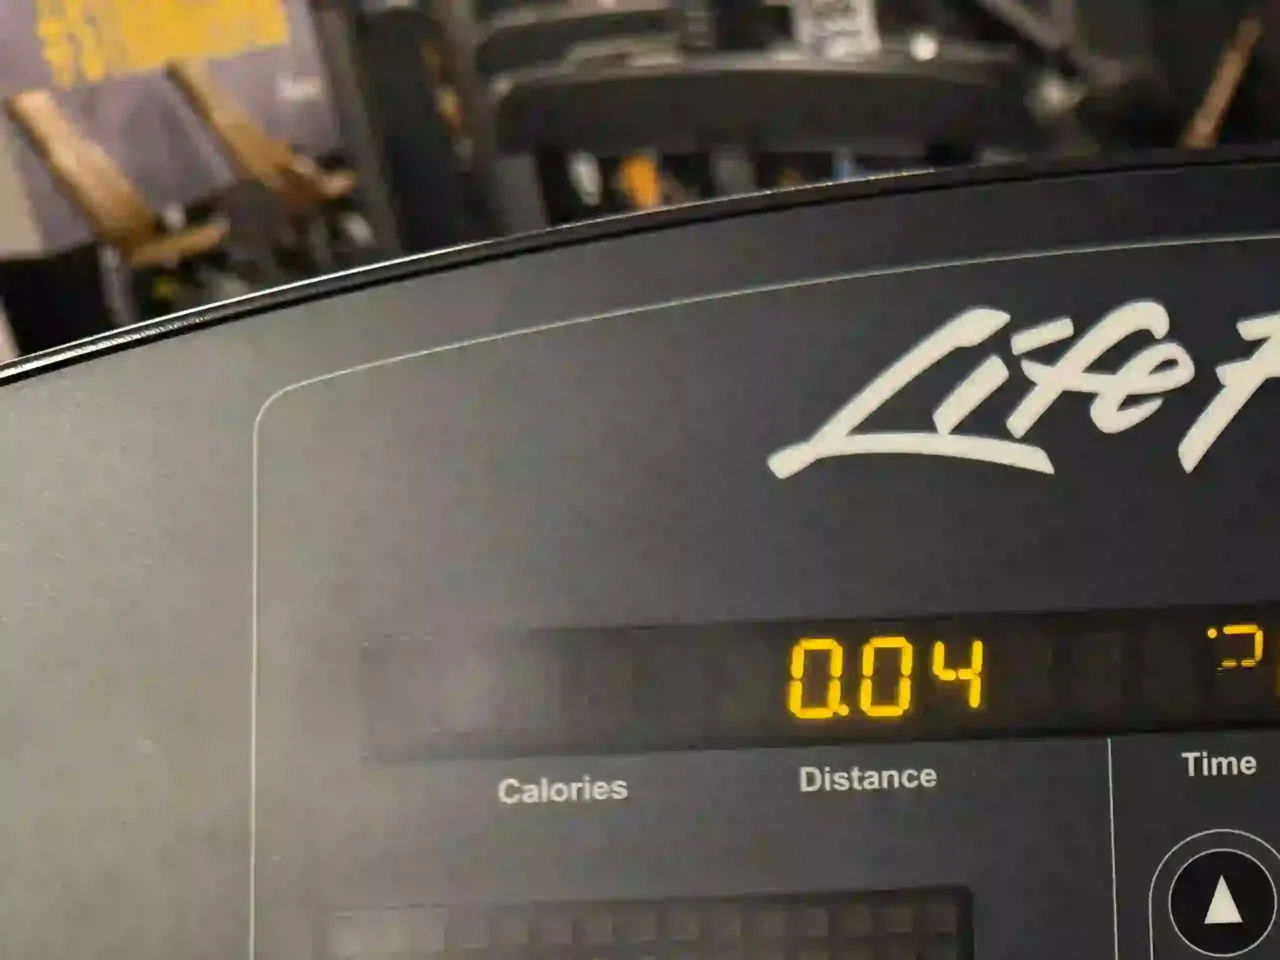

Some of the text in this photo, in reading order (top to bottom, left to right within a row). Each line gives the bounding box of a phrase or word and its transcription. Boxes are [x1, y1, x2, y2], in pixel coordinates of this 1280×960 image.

[766, 299, 1195, 478] Life
[789, 636, 983, 718] 0.04
[1181, 751, 1257, 778] Time
[498, 777, 629, 804] Calories
[799, 765, 938, 793] Distance
